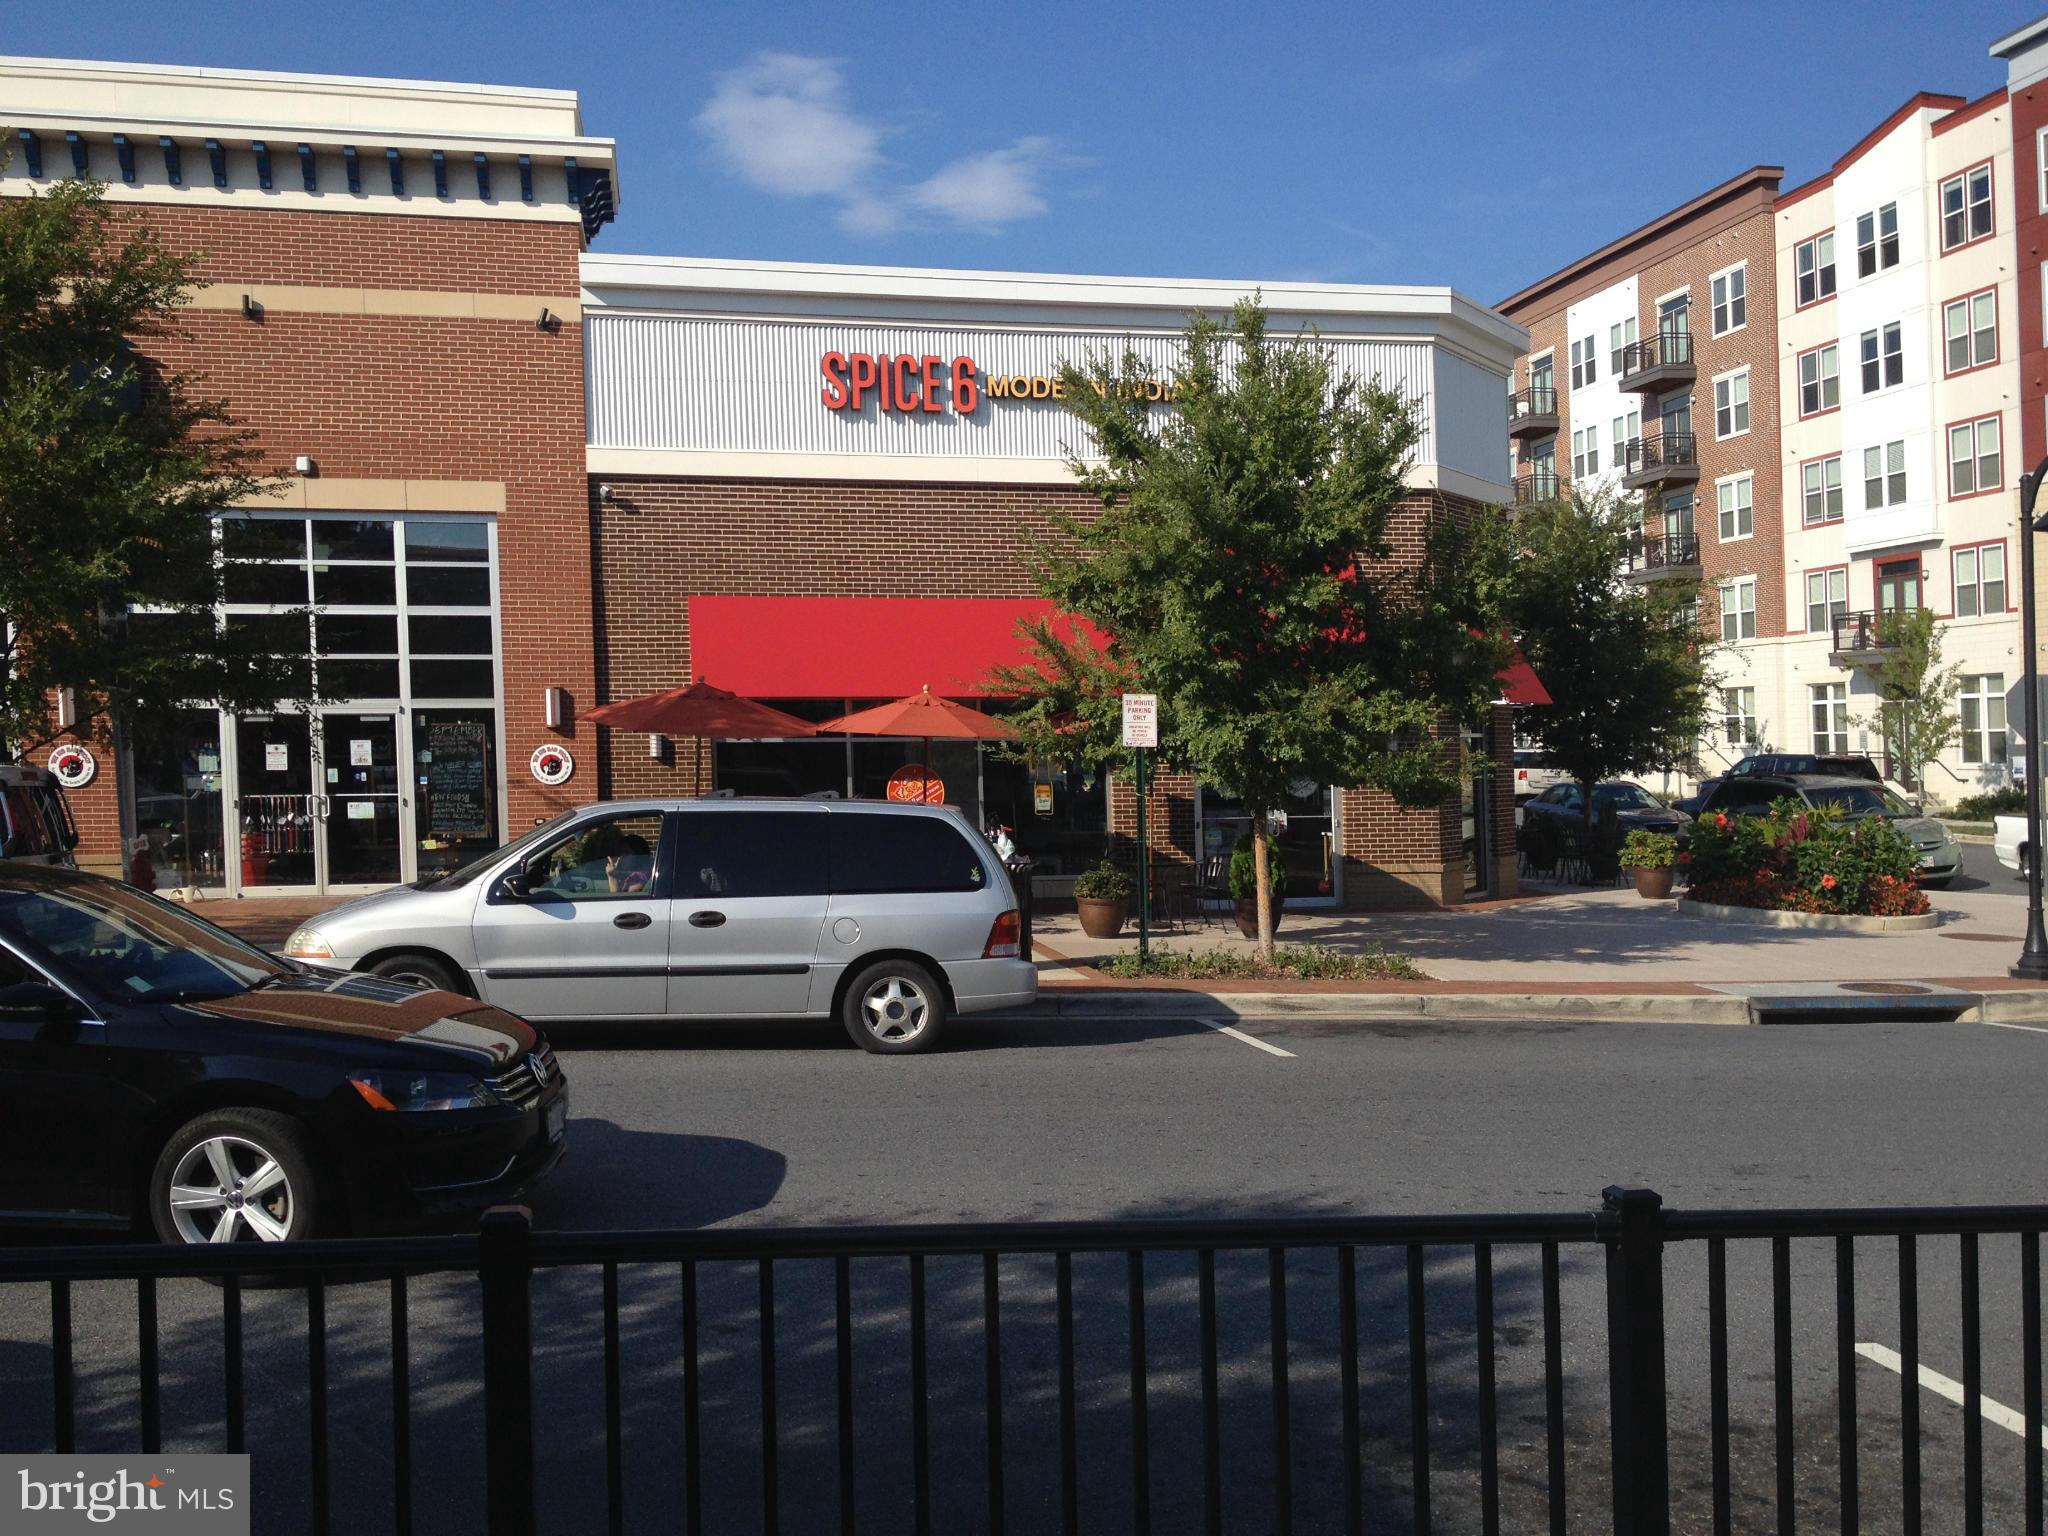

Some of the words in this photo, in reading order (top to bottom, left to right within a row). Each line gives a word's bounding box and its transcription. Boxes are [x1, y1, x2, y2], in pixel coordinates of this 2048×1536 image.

[821, 351, 943, 413] SPICE
[951, 355, 977, 414] 6
[987, 374, 1107, 400] MODEN
